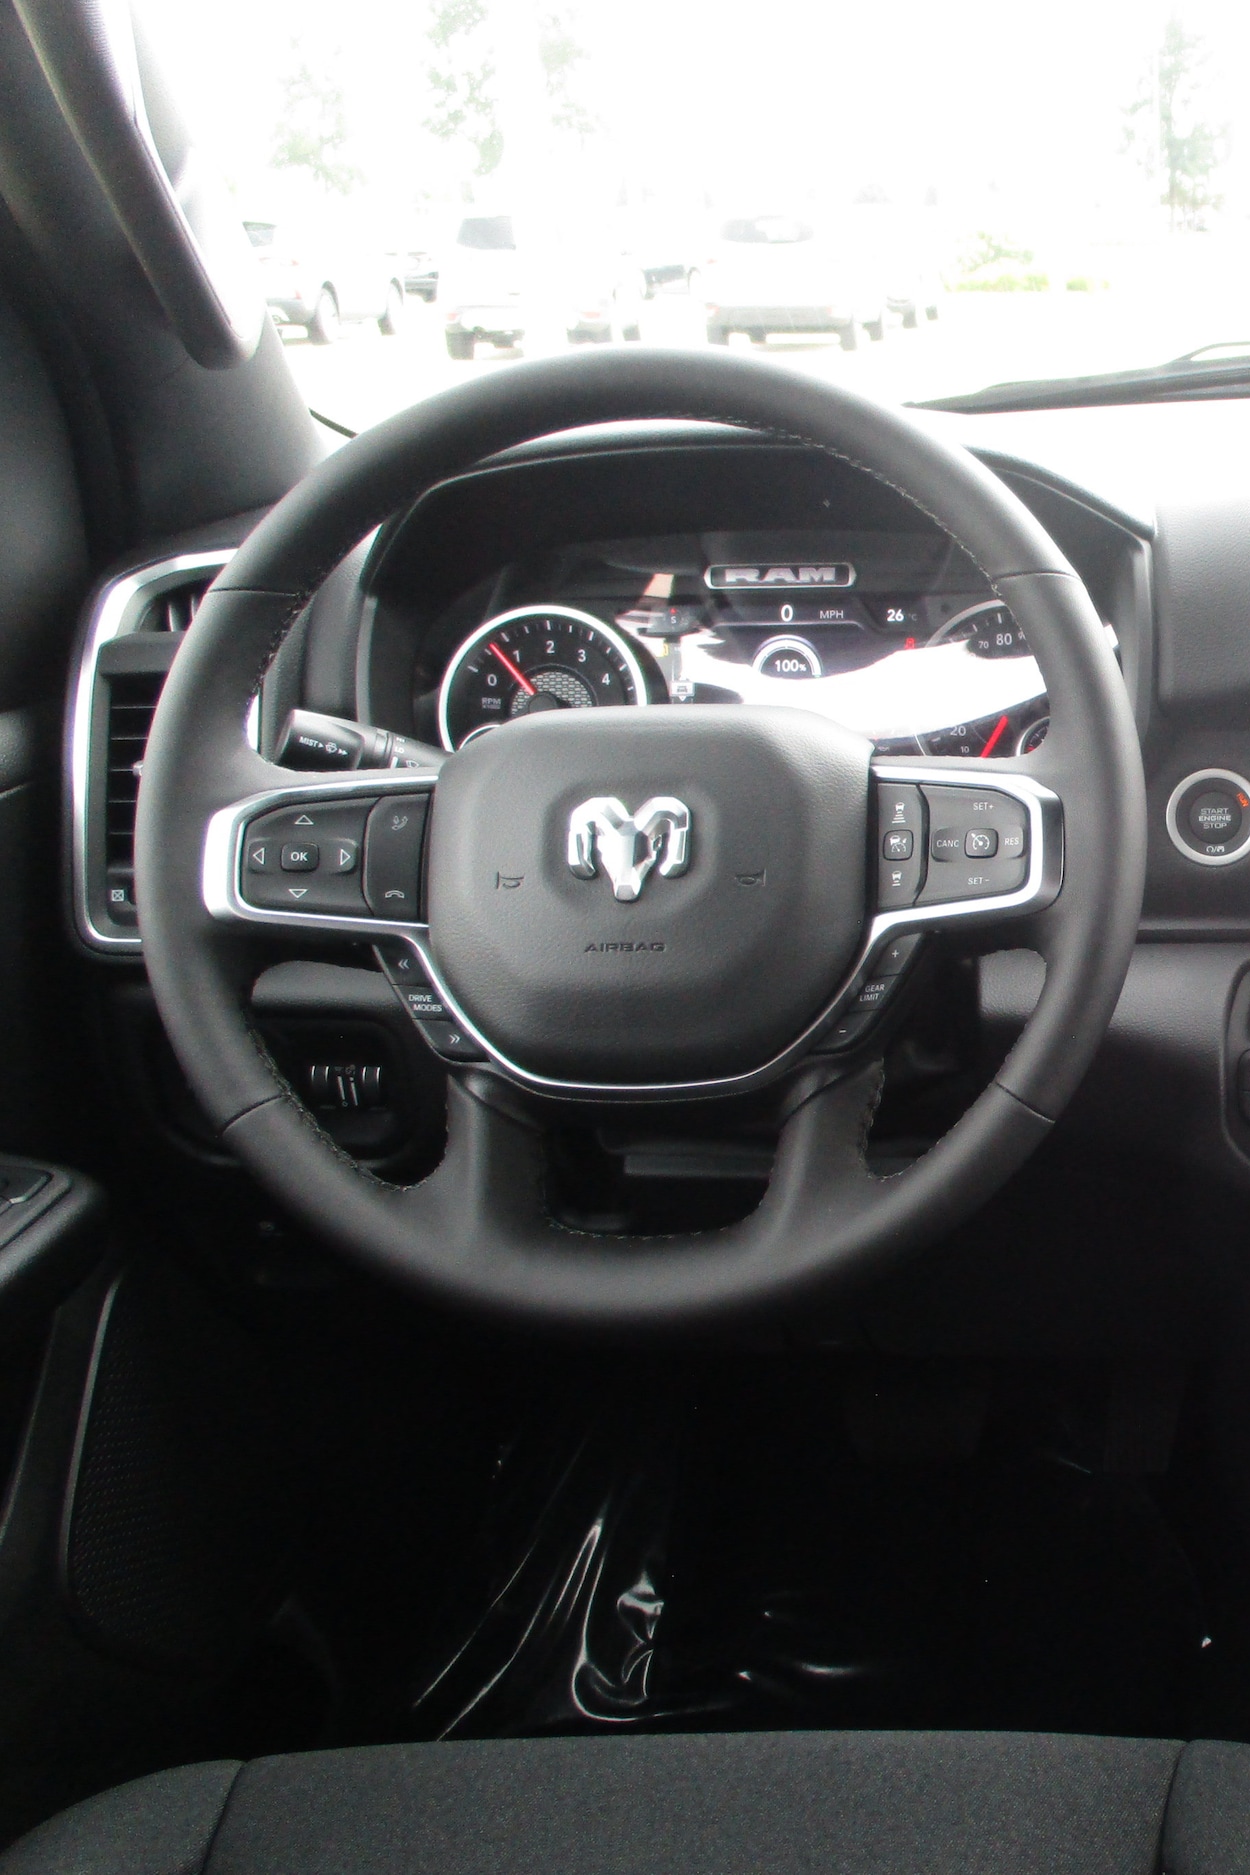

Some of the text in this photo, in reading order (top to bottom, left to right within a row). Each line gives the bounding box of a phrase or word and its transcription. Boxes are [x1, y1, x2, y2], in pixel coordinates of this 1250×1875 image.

[725, 568, 835, 583] RAM
[780, 605, 844, 621] 0 MPH
[887, 609, 903, 621] 26
[996, 633, 1012, 645] 80
[546, 640, 555, 653] 2
[978, 641, 989, 649] 70
[513, 650, 520, 662] 1
[578, 649, 586, 662] 3
[774, 659, 806, 672] 100%
[487, 674, 497, 687] 0
[602, 673, 610, 685] 4
[951, 727, 966, 736] 20
[299, 736, 319, 747] MIST
[936, 840, 960, 848] CANC
[1004, 838, 1019, 846] RES
[290, 852, 308, 862] OK
[584, 942, 667, 953] AIRBAG
[865, 984, 885, 993] GEAR
[408, 994, 432, 1003] DRIVE
[860, 993, 880, 1002] LIMIT
[413, 1004, 442, 1012] MODES
